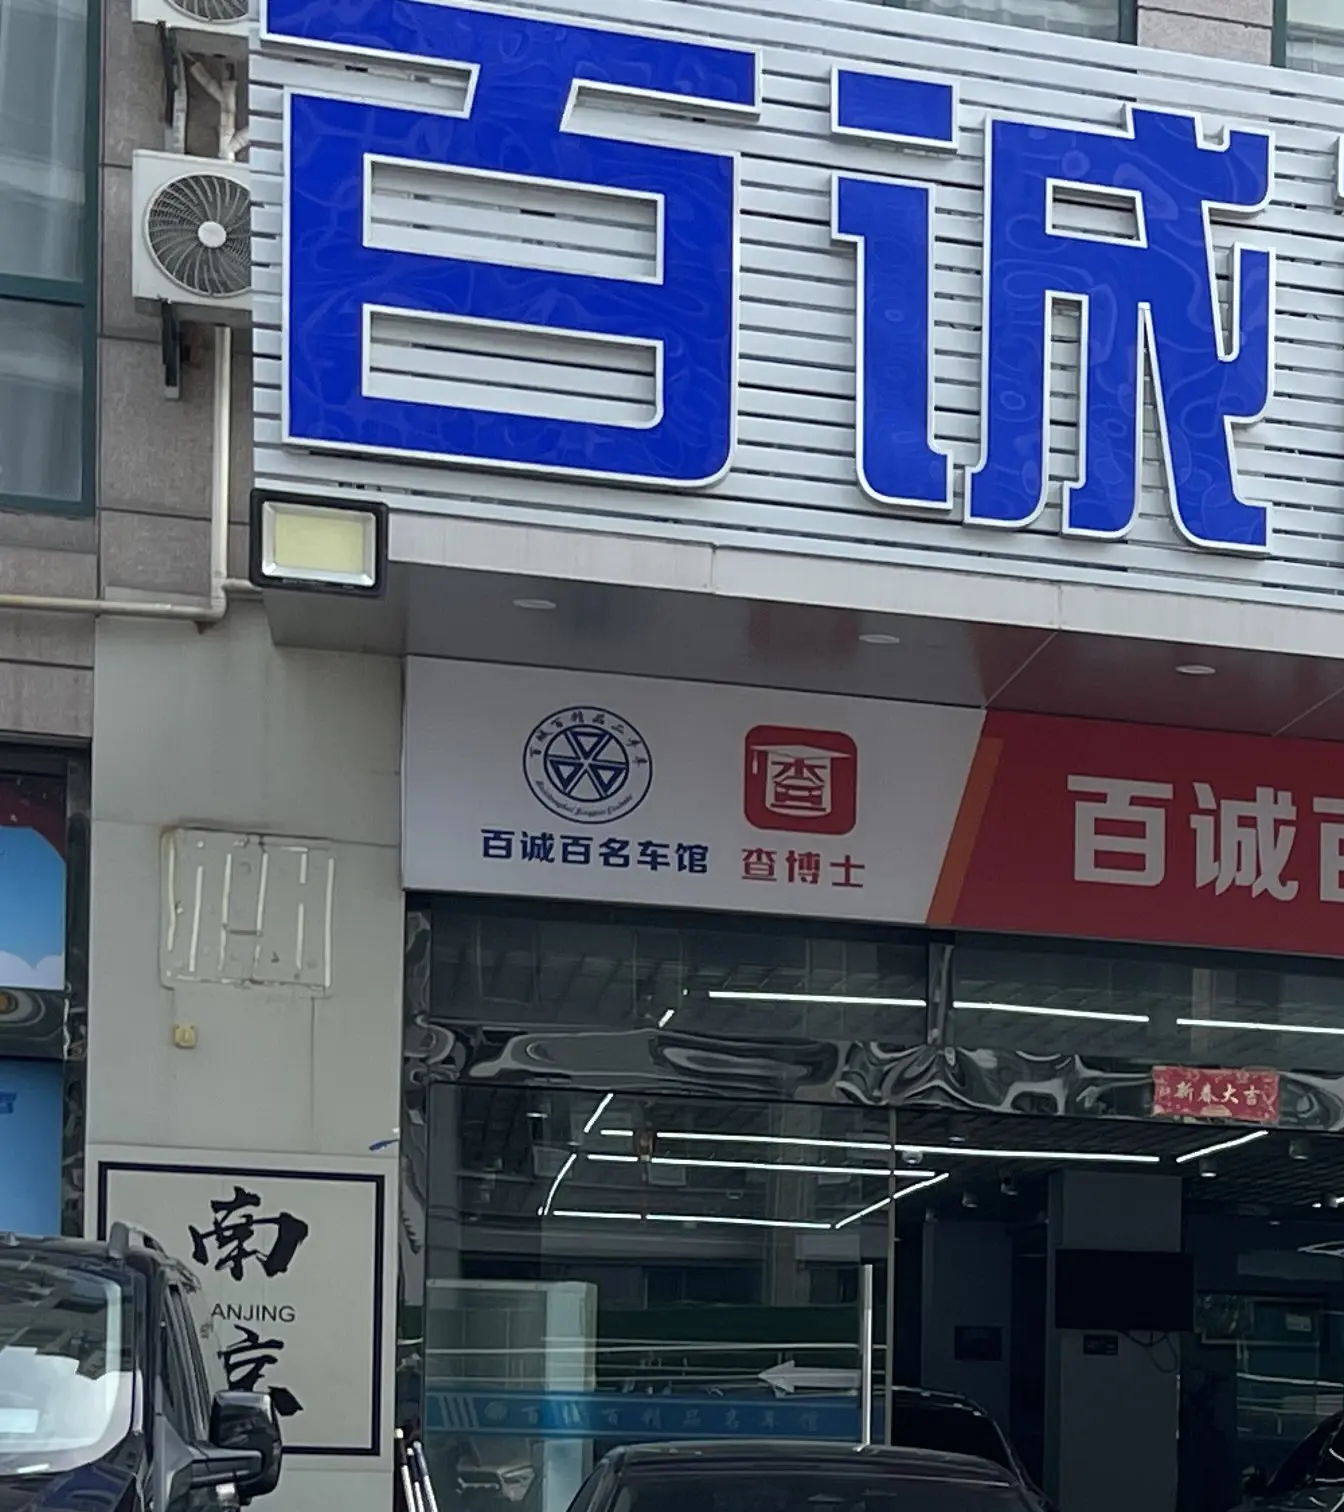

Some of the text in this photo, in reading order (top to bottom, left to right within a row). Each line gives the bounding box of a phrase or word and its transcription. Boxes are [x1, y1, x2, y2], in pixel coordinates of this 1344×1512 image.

[481, 829, 709, 874] 百诚百名车馆
[741, 847, 866, 888] 查博士
